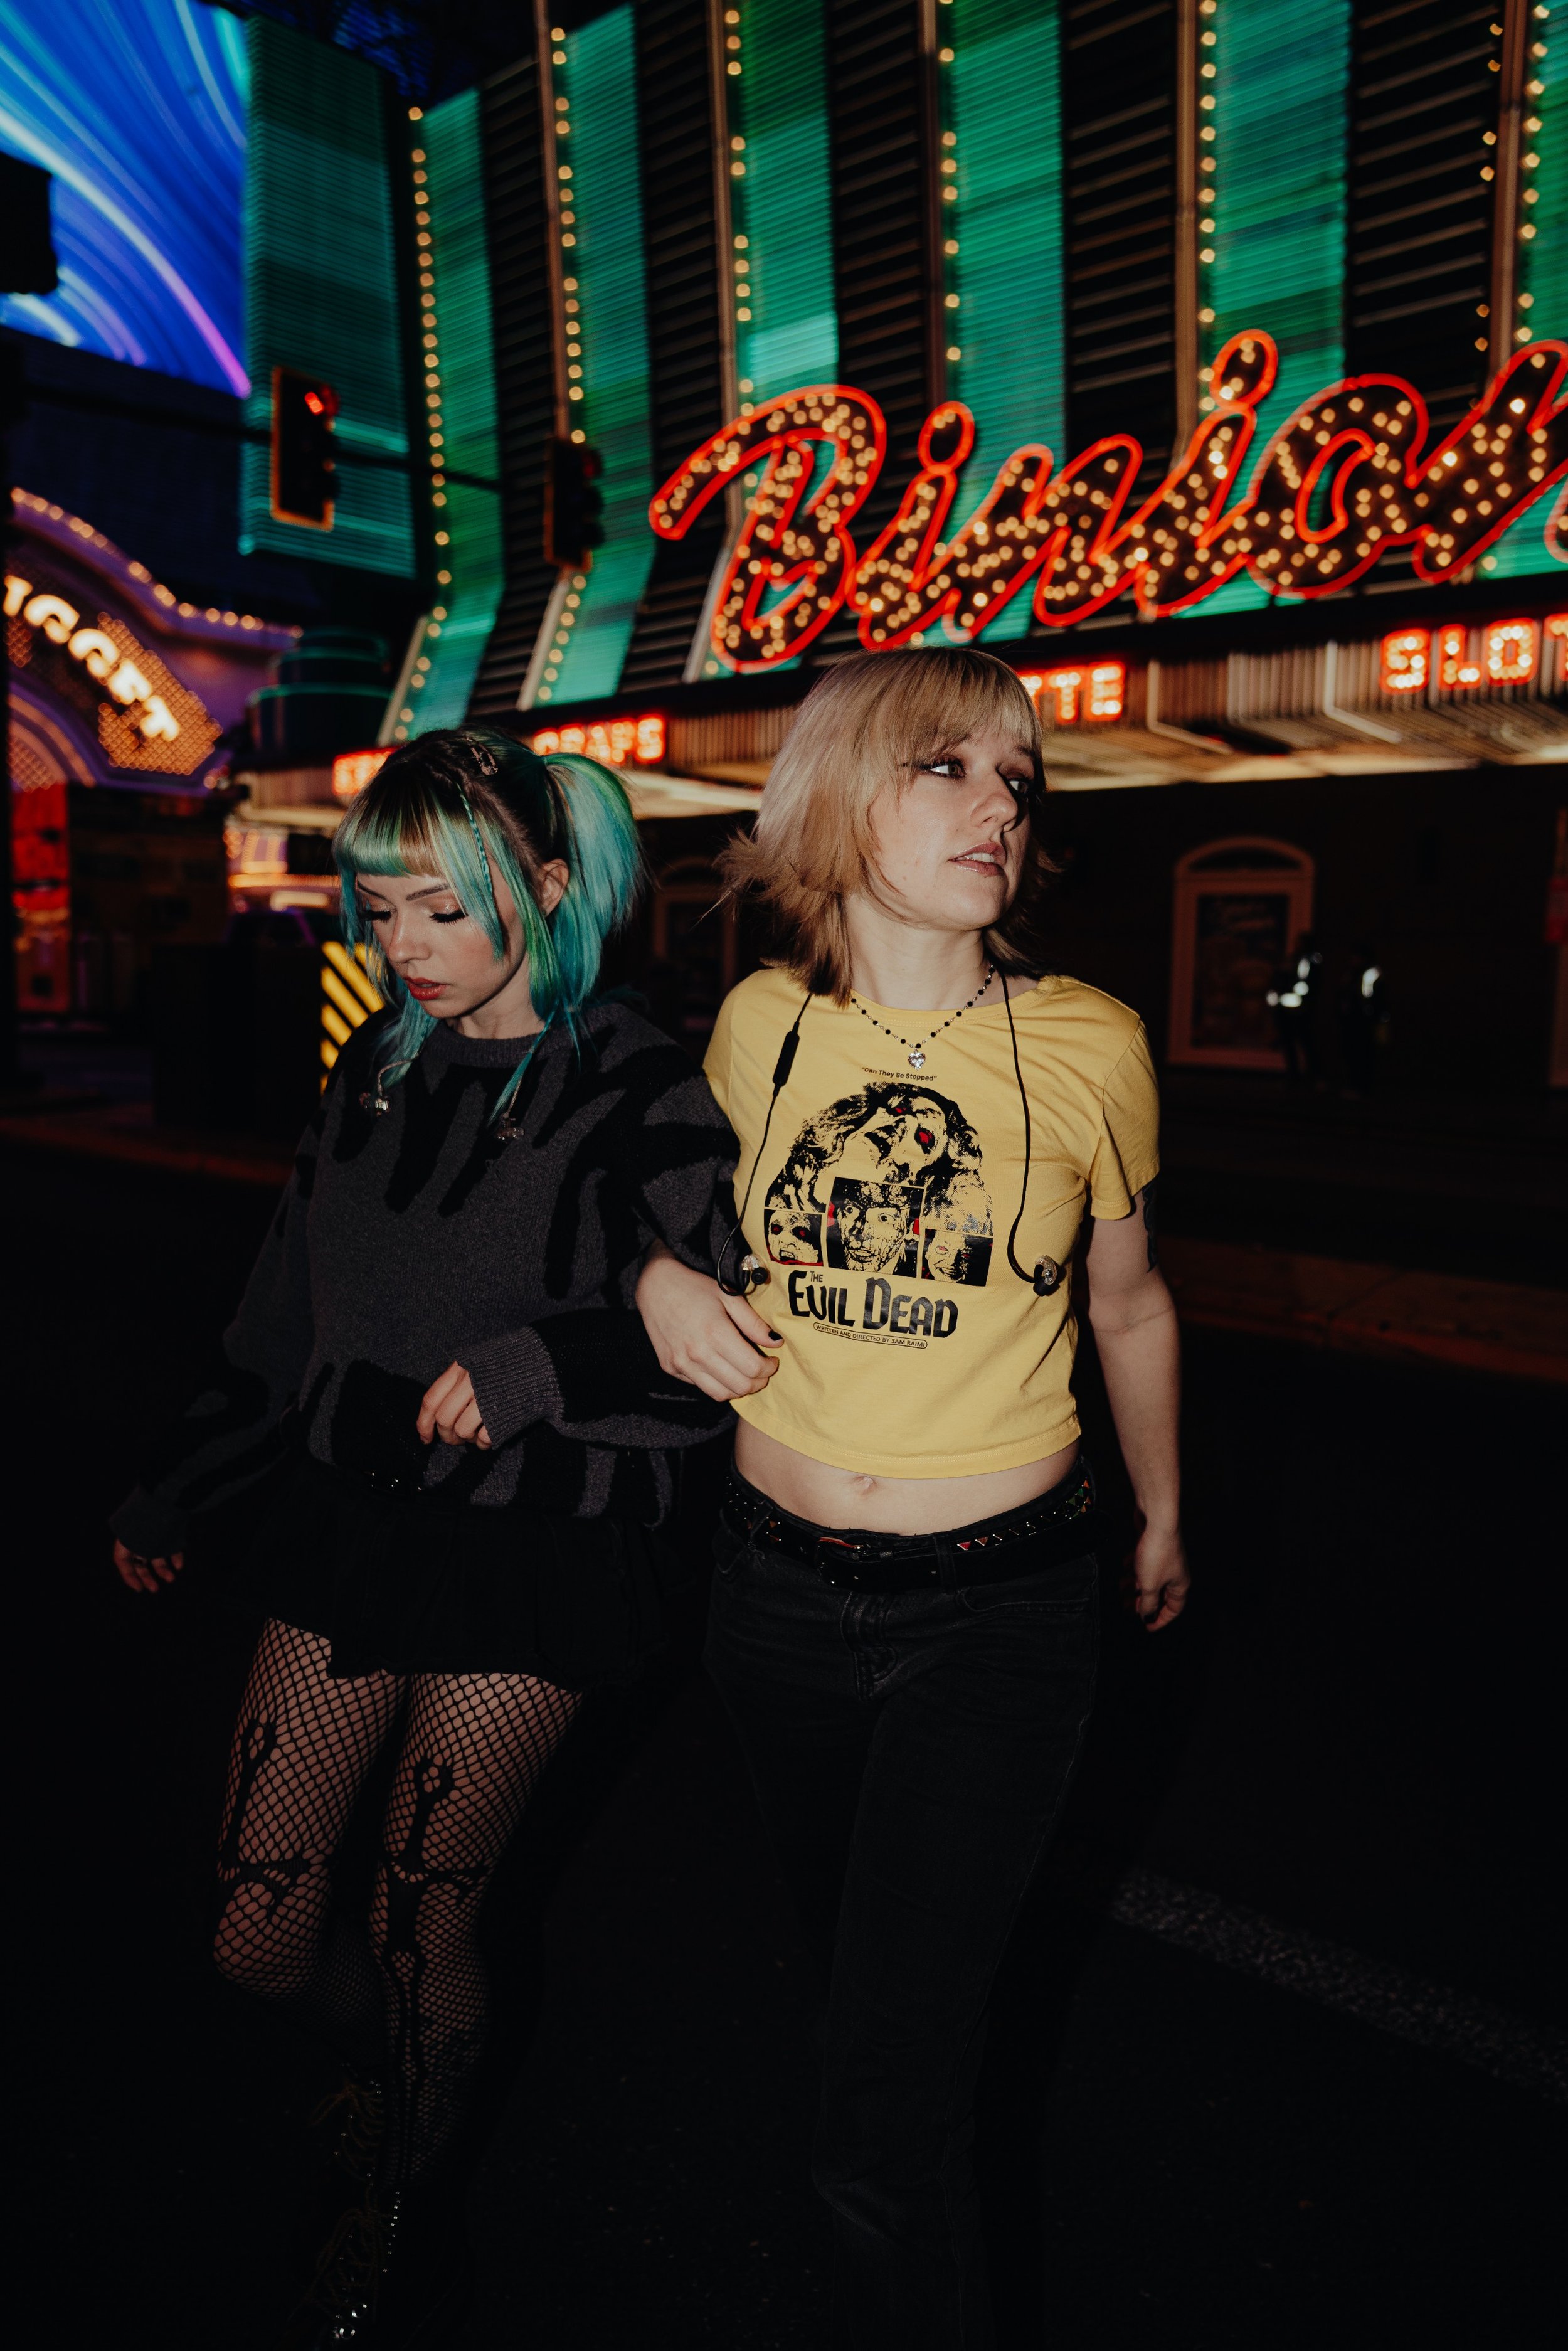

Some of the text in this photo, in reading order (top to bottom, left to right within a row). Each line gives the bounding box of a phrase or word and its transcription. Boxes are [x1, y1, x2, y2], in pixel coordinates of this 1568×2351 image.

[879, 1069, 895, 1078] They
[810, 1270, 824, 1283] THE
[788, 1270, 959, 1338] EVIL DEAD
[816, 1324, 839, 1334] WRITTEN
[852, 1333, 881, 1342] DIRECTED
